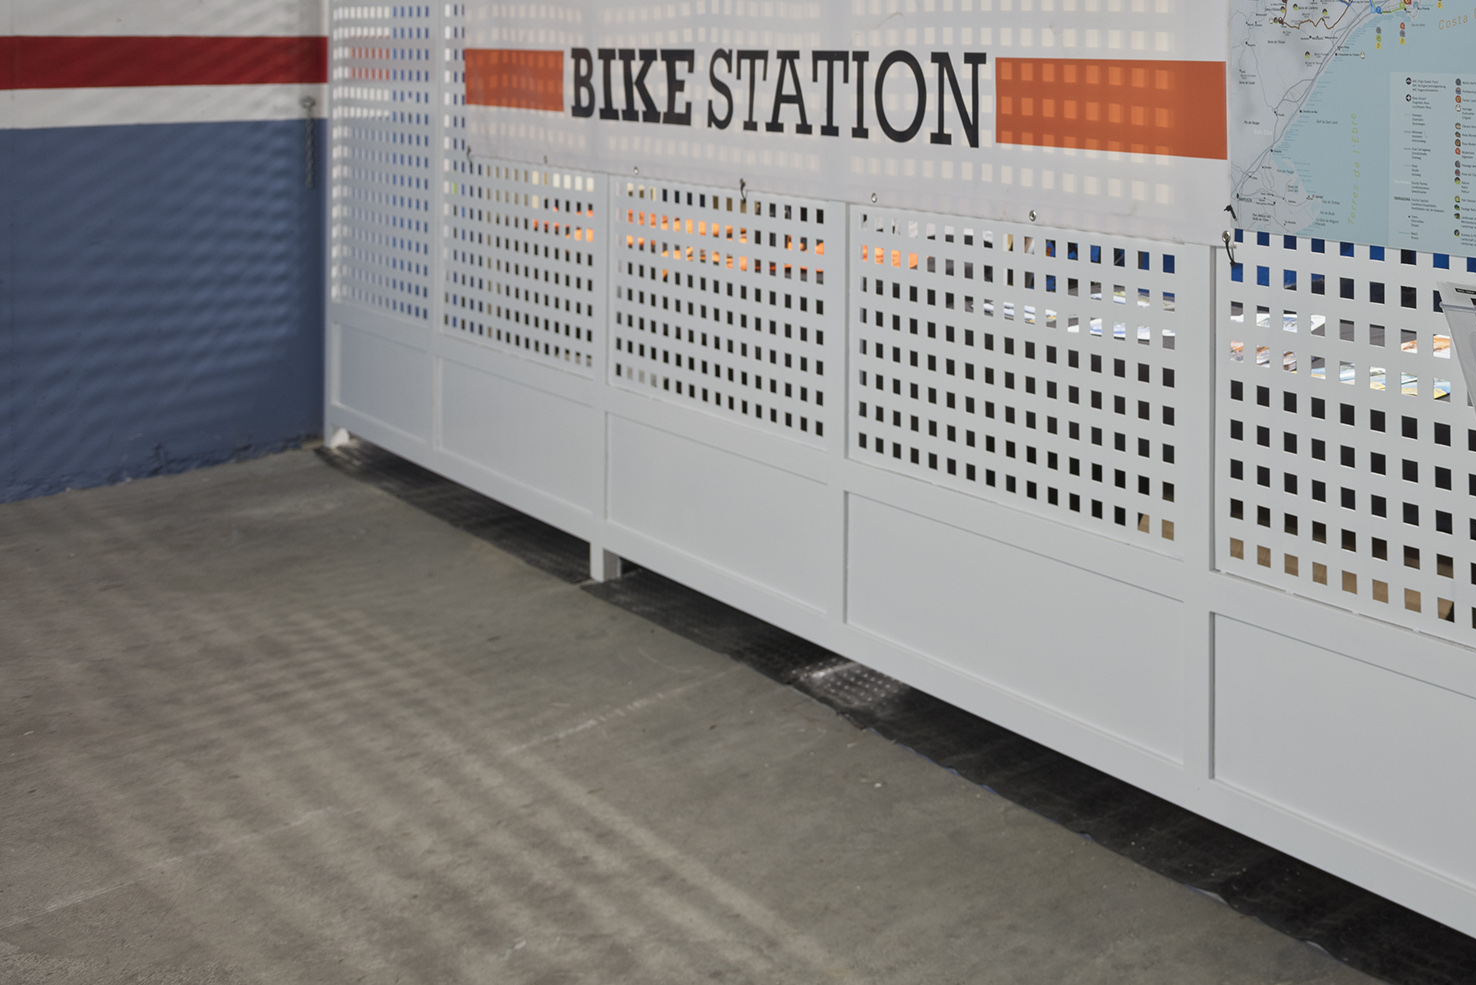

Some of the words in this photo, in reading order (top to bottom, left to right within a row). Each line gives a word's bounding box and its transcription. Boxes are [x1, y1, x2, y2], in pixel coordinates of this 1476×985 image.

[1438, 15, 1468, 30] Costa
[569, 47, 694, 126] BIKE
[708, 49, 987, 148] STATION
[1347, 183, 1360, 225] Terres
[1354, 161, 1361, 178] de
